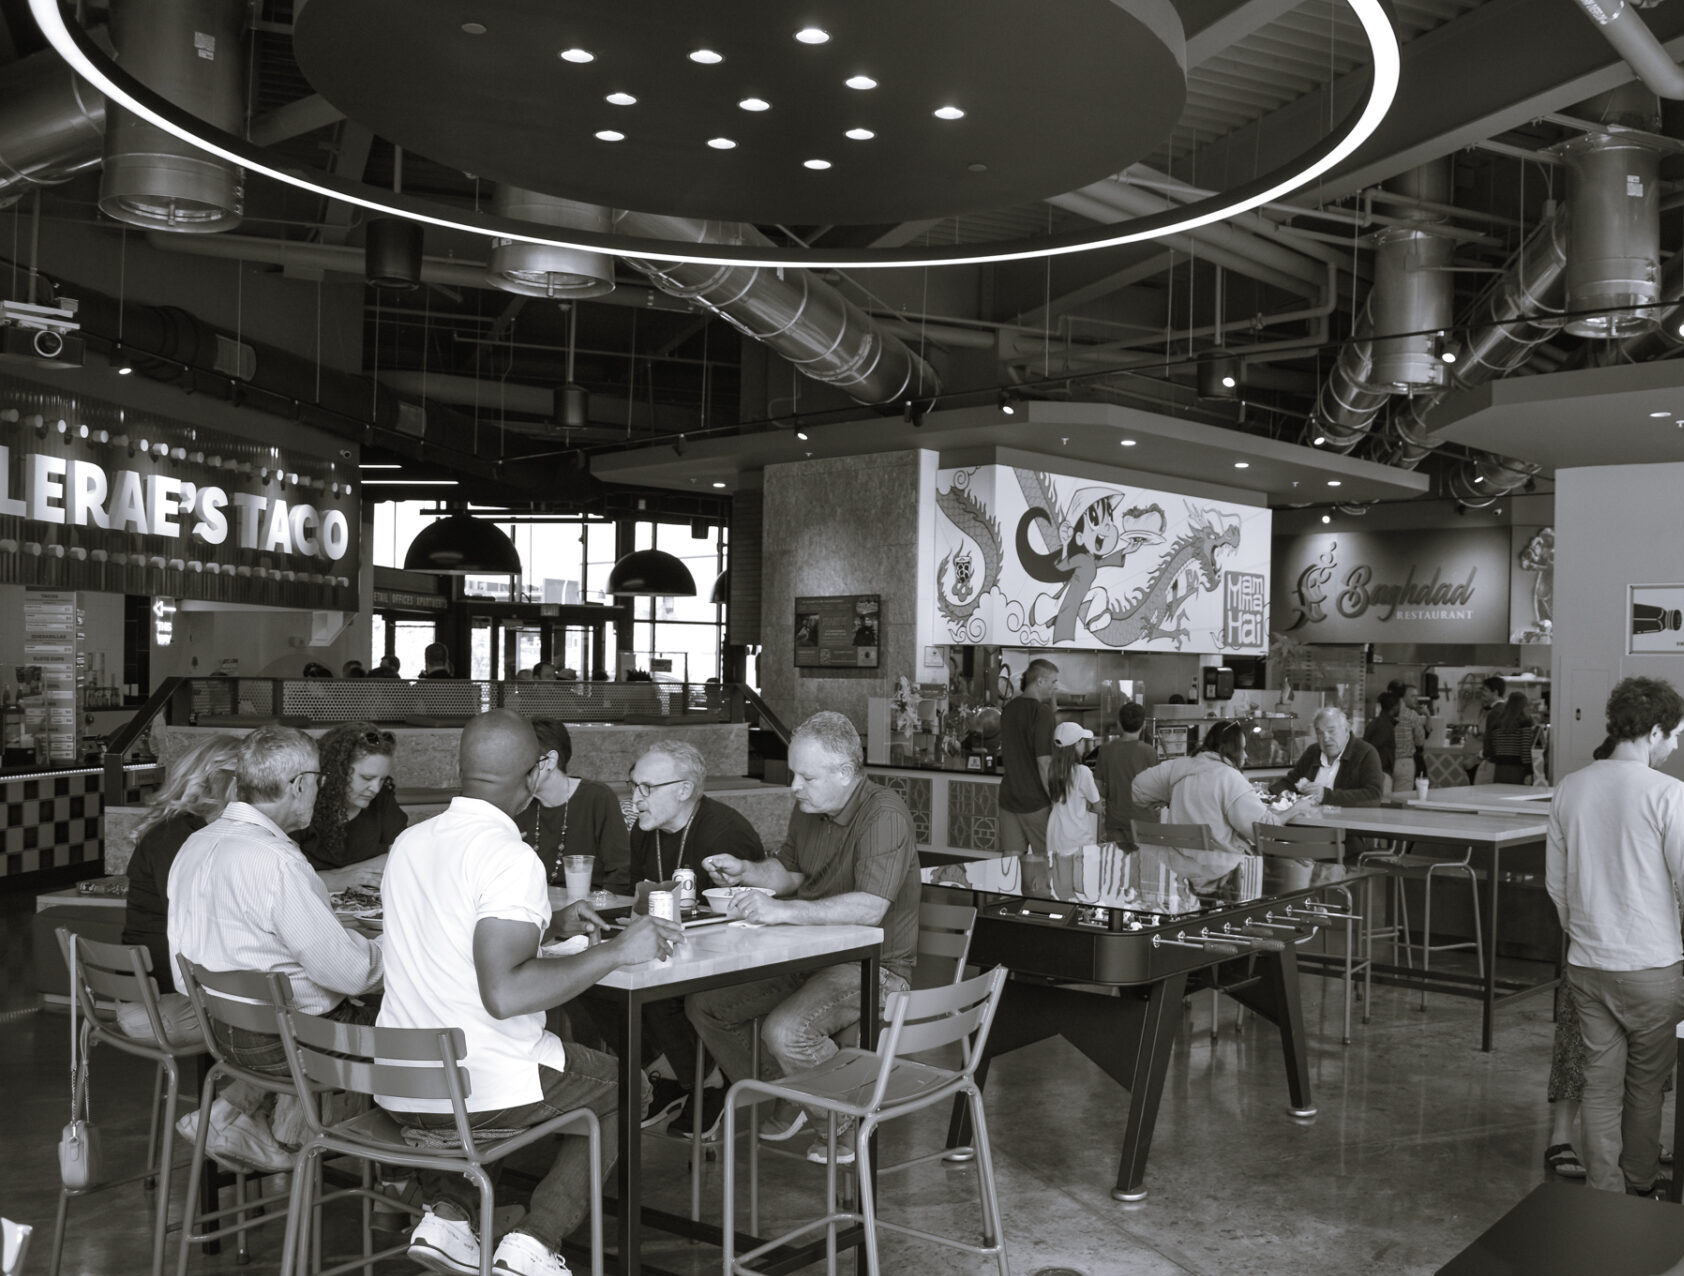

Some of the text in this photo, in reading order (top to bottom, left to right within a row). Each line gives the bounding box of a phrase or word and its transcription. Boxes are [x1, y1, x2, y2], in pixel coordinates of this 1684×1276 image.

[234, 492, 348, 560] TACO
[1336, 564, 1477, 622] Baghdad
[1396, 609, 1474, 620] RESTAURANT
[1228, 611, 1262, 645] Hai
